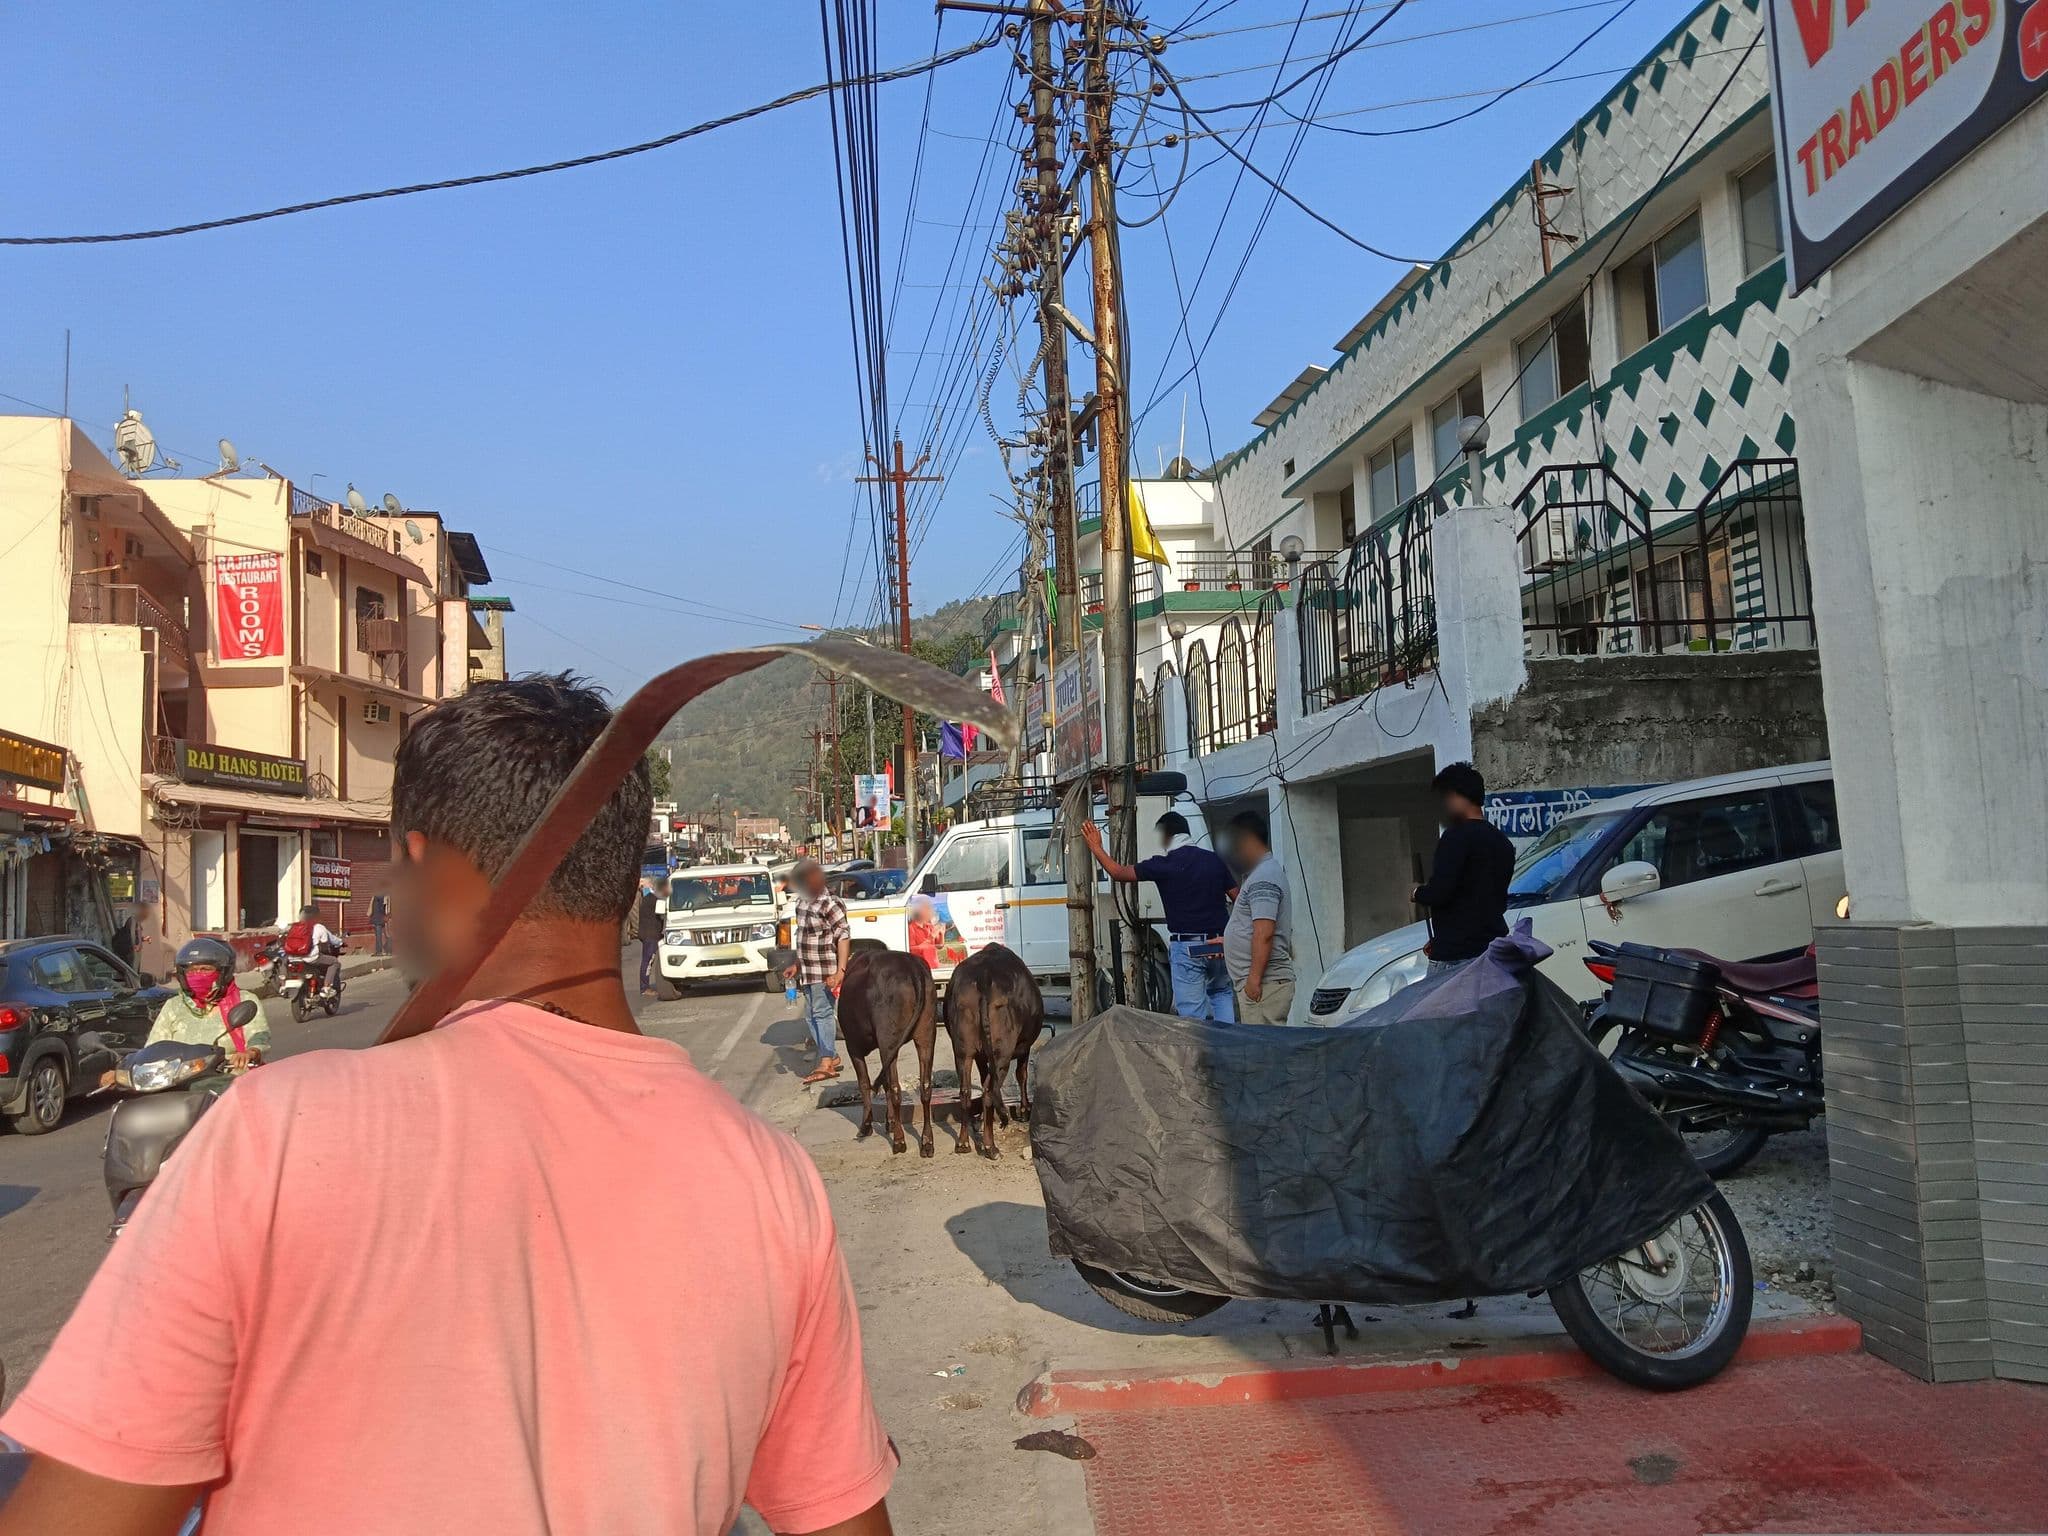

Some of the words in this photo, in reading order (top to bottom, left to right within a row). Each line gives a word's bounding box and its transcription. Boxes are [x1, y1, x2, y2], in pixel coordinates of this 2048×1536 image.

[1797, 0, 1996, 197] TRADERS
[219, 570, 278, 586] RESTAURANT
[239, 586, 264, 657] ROOMS
[187, 749, 215, 771] RAJ
[218, 754, 257, 776] HANS
[260, 761, 303, 783] HOTEL
